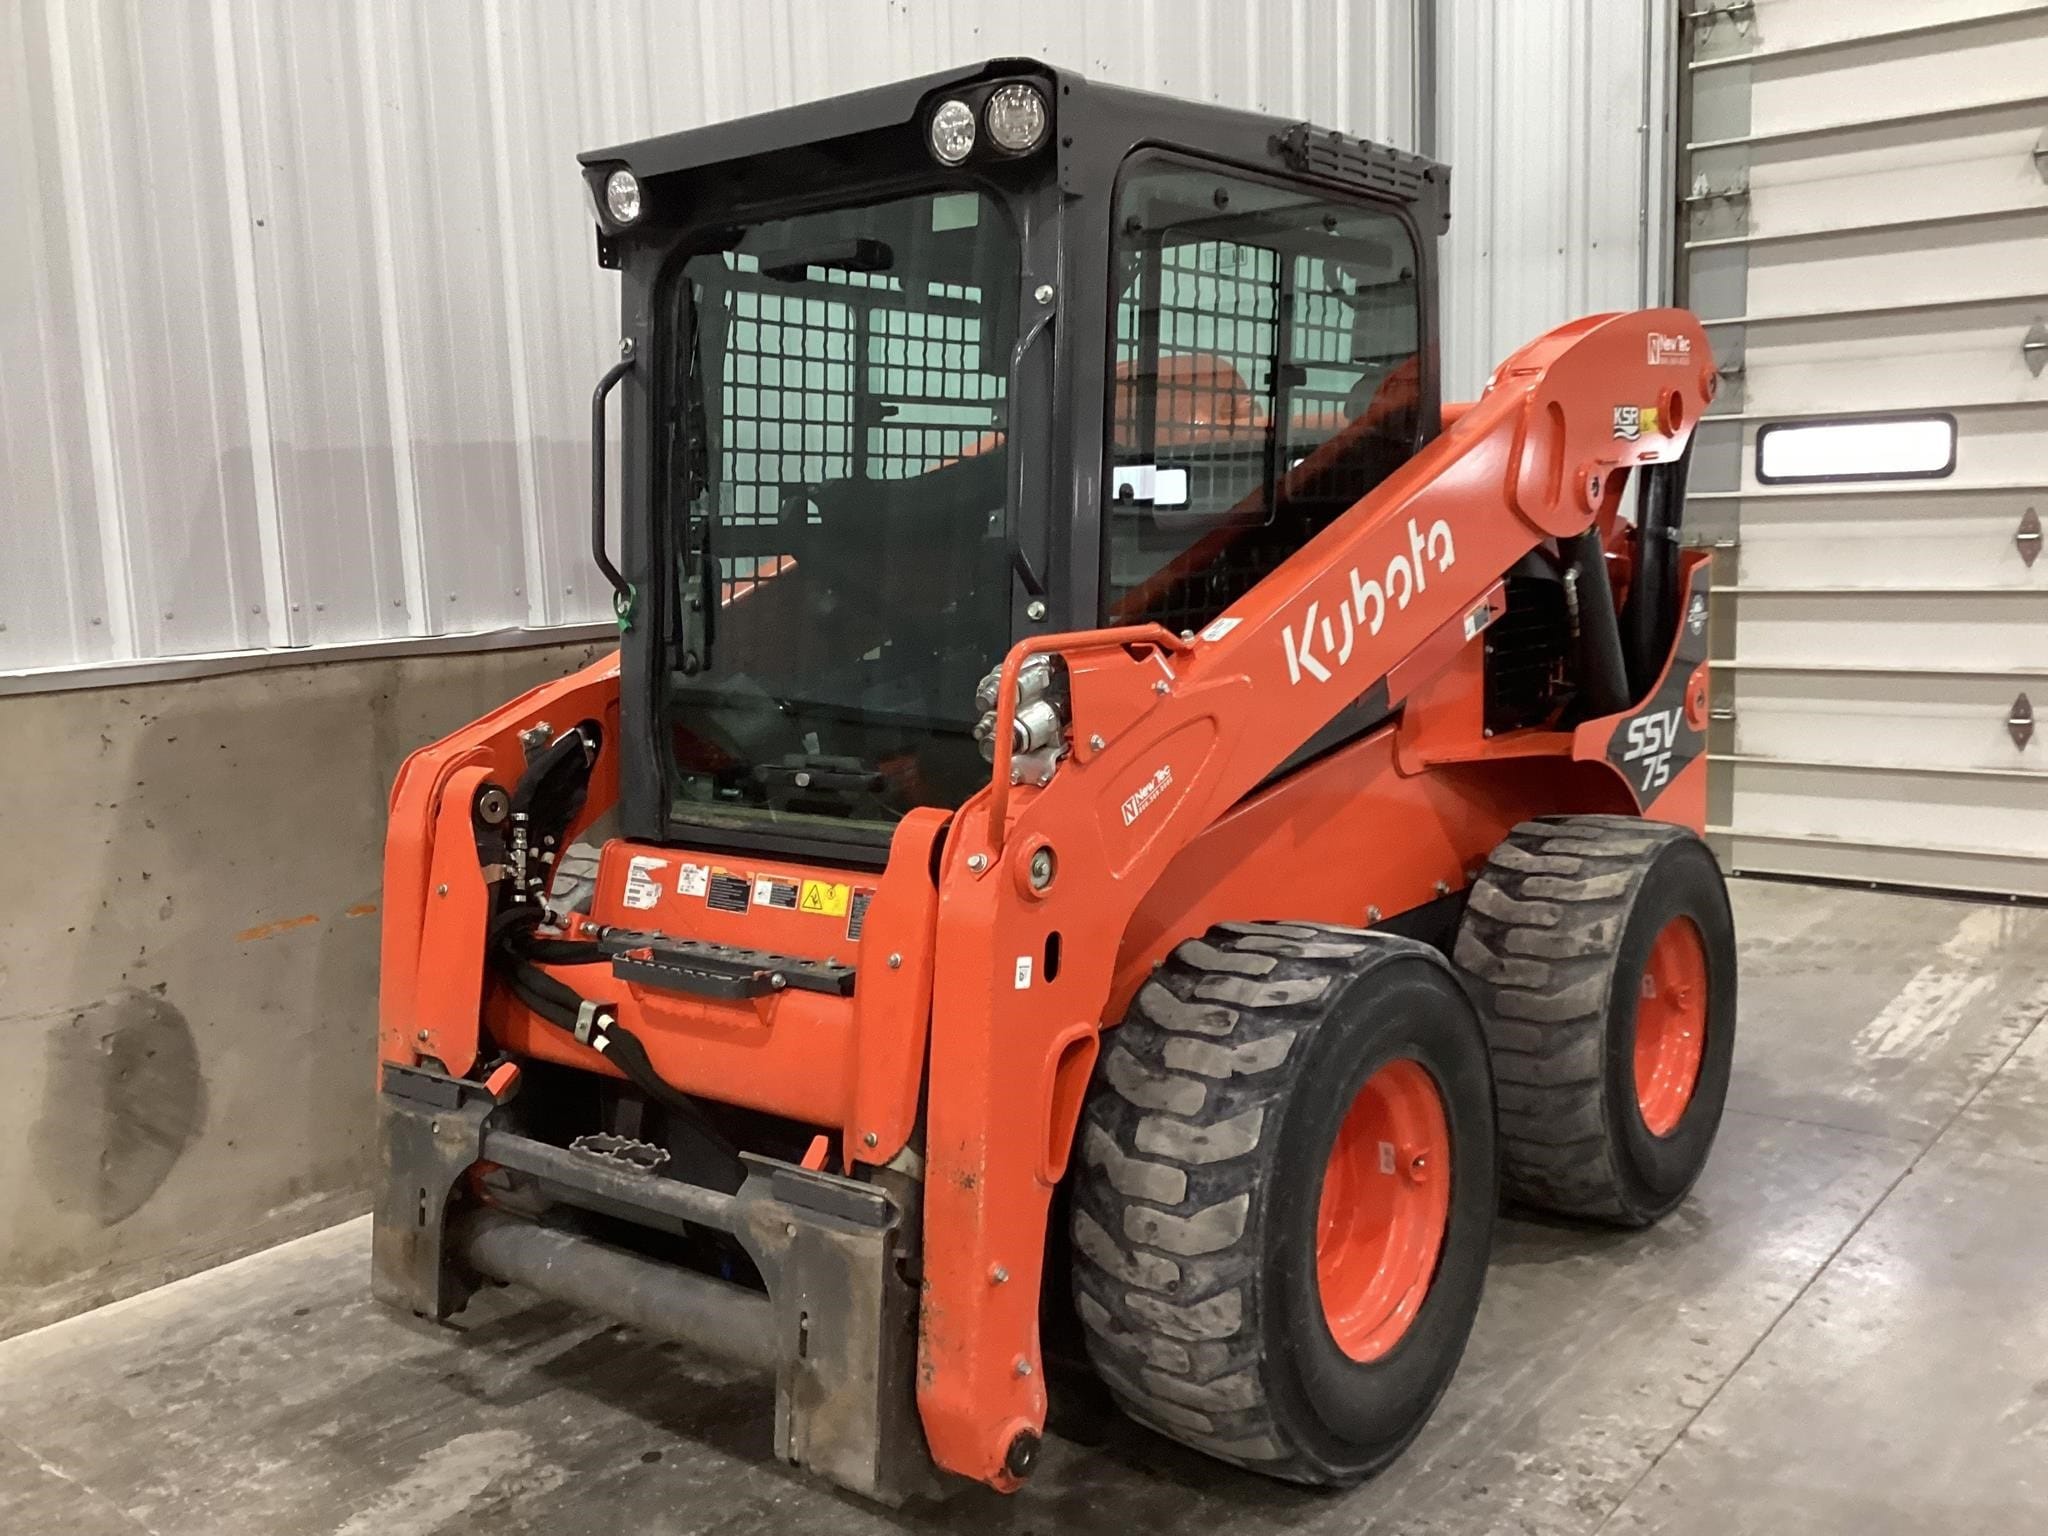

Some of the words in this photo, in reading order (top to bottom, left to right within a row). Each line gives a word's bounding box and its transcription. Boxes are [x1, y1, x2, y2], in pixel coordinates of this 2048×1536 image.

[1282, 518, 1456, 686] Kubota
[1623, 706, 1684, 762] SSV
[1641, 751, 1672, 792] 75
